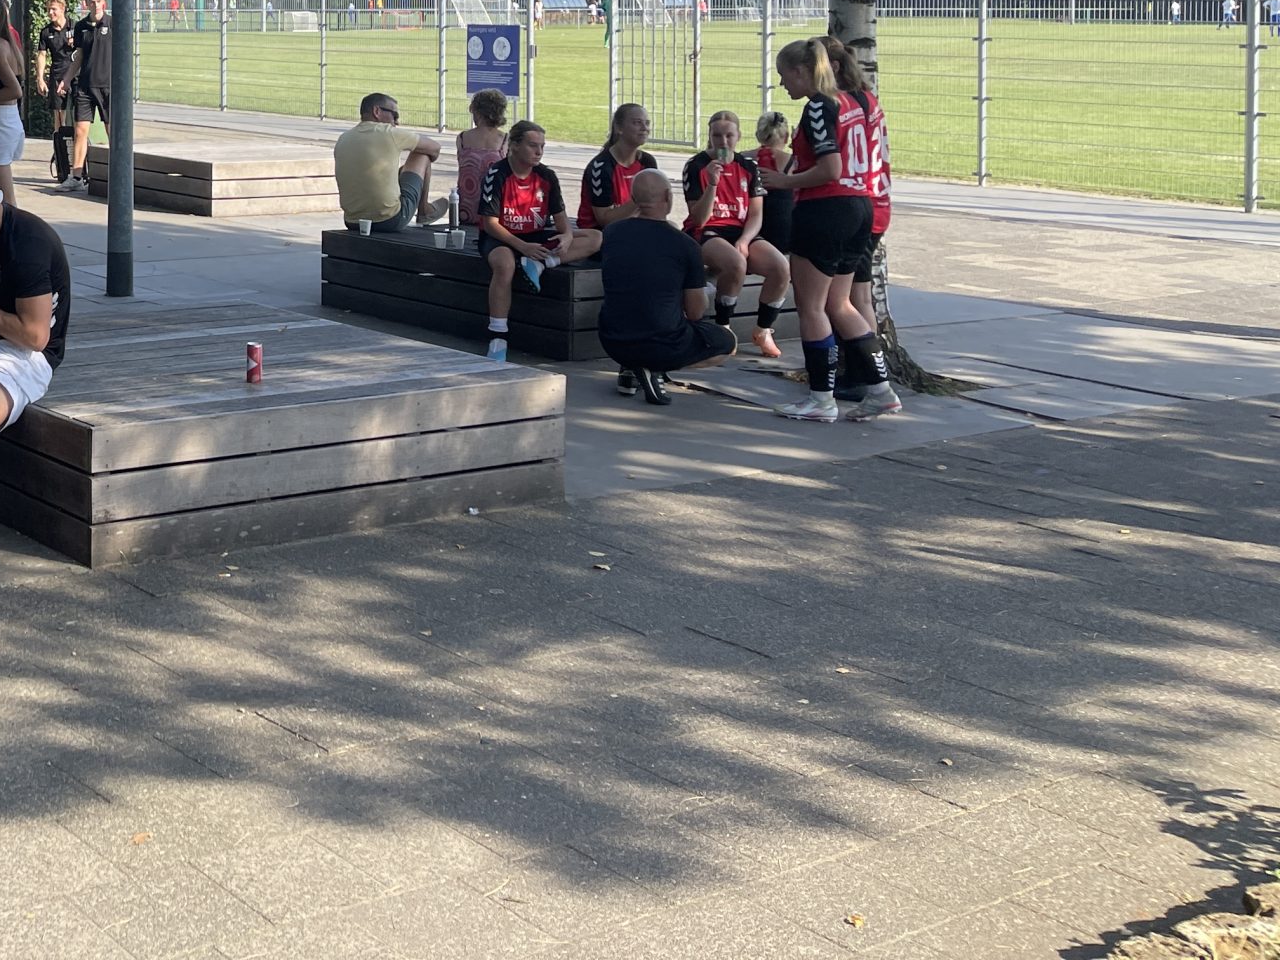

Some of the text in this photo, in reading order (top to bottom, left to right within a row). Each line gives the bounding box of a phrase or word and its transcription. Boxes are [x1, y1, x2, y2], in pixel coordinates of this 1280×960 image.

[848, 123, 869, 177] 10
[503, 207, 515, 215] FN
[503, 214, 532, 223] GLOBAL
